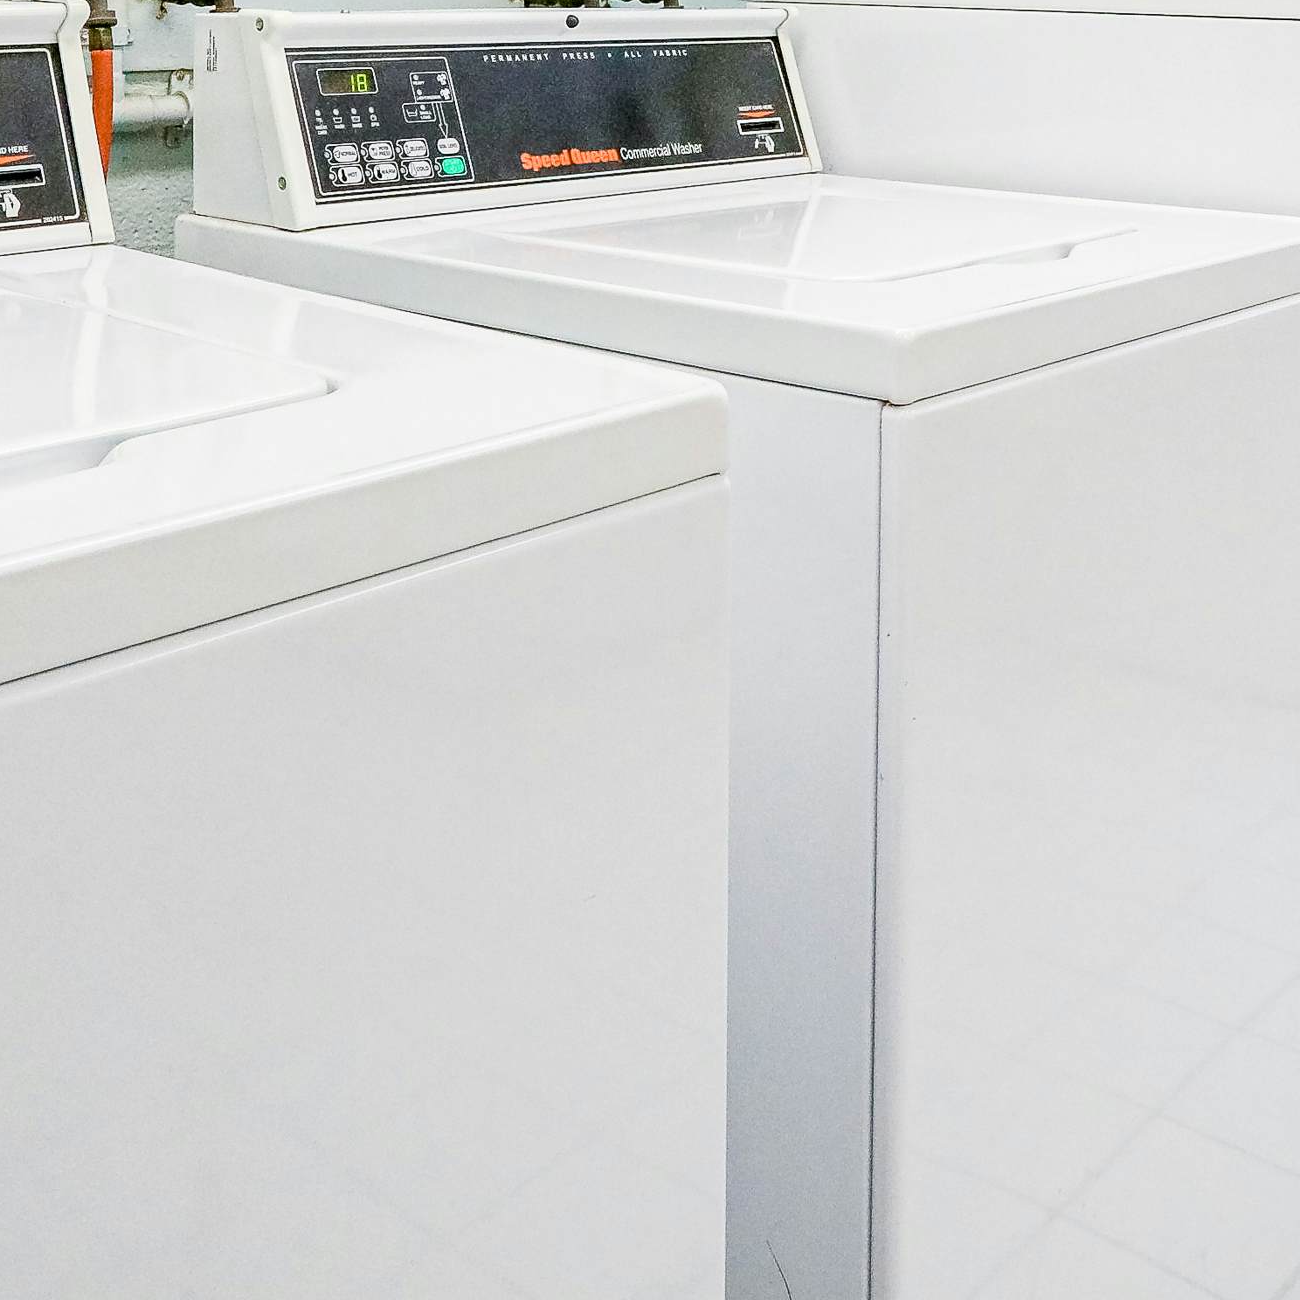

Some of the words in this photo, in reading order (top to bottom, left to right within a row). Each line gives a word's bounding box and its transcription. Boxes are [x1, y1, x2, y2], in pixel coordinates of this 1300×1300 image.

[483, 53, 550, 63] PERMANENT
[562, 52, 596, 60] PRESS
[624, 50, 642, 58] ALL
[653, 49, 688, 57] FABRIC
[351, 74, 368, 92] 18
[8, 145, 29, 153] HERE
[520, 149, 571, 171] Speed
[571, 148, 620, 164] Queen
[620, 143, 671, 161] Commercial
[671, 142, 702, 155] Washer
